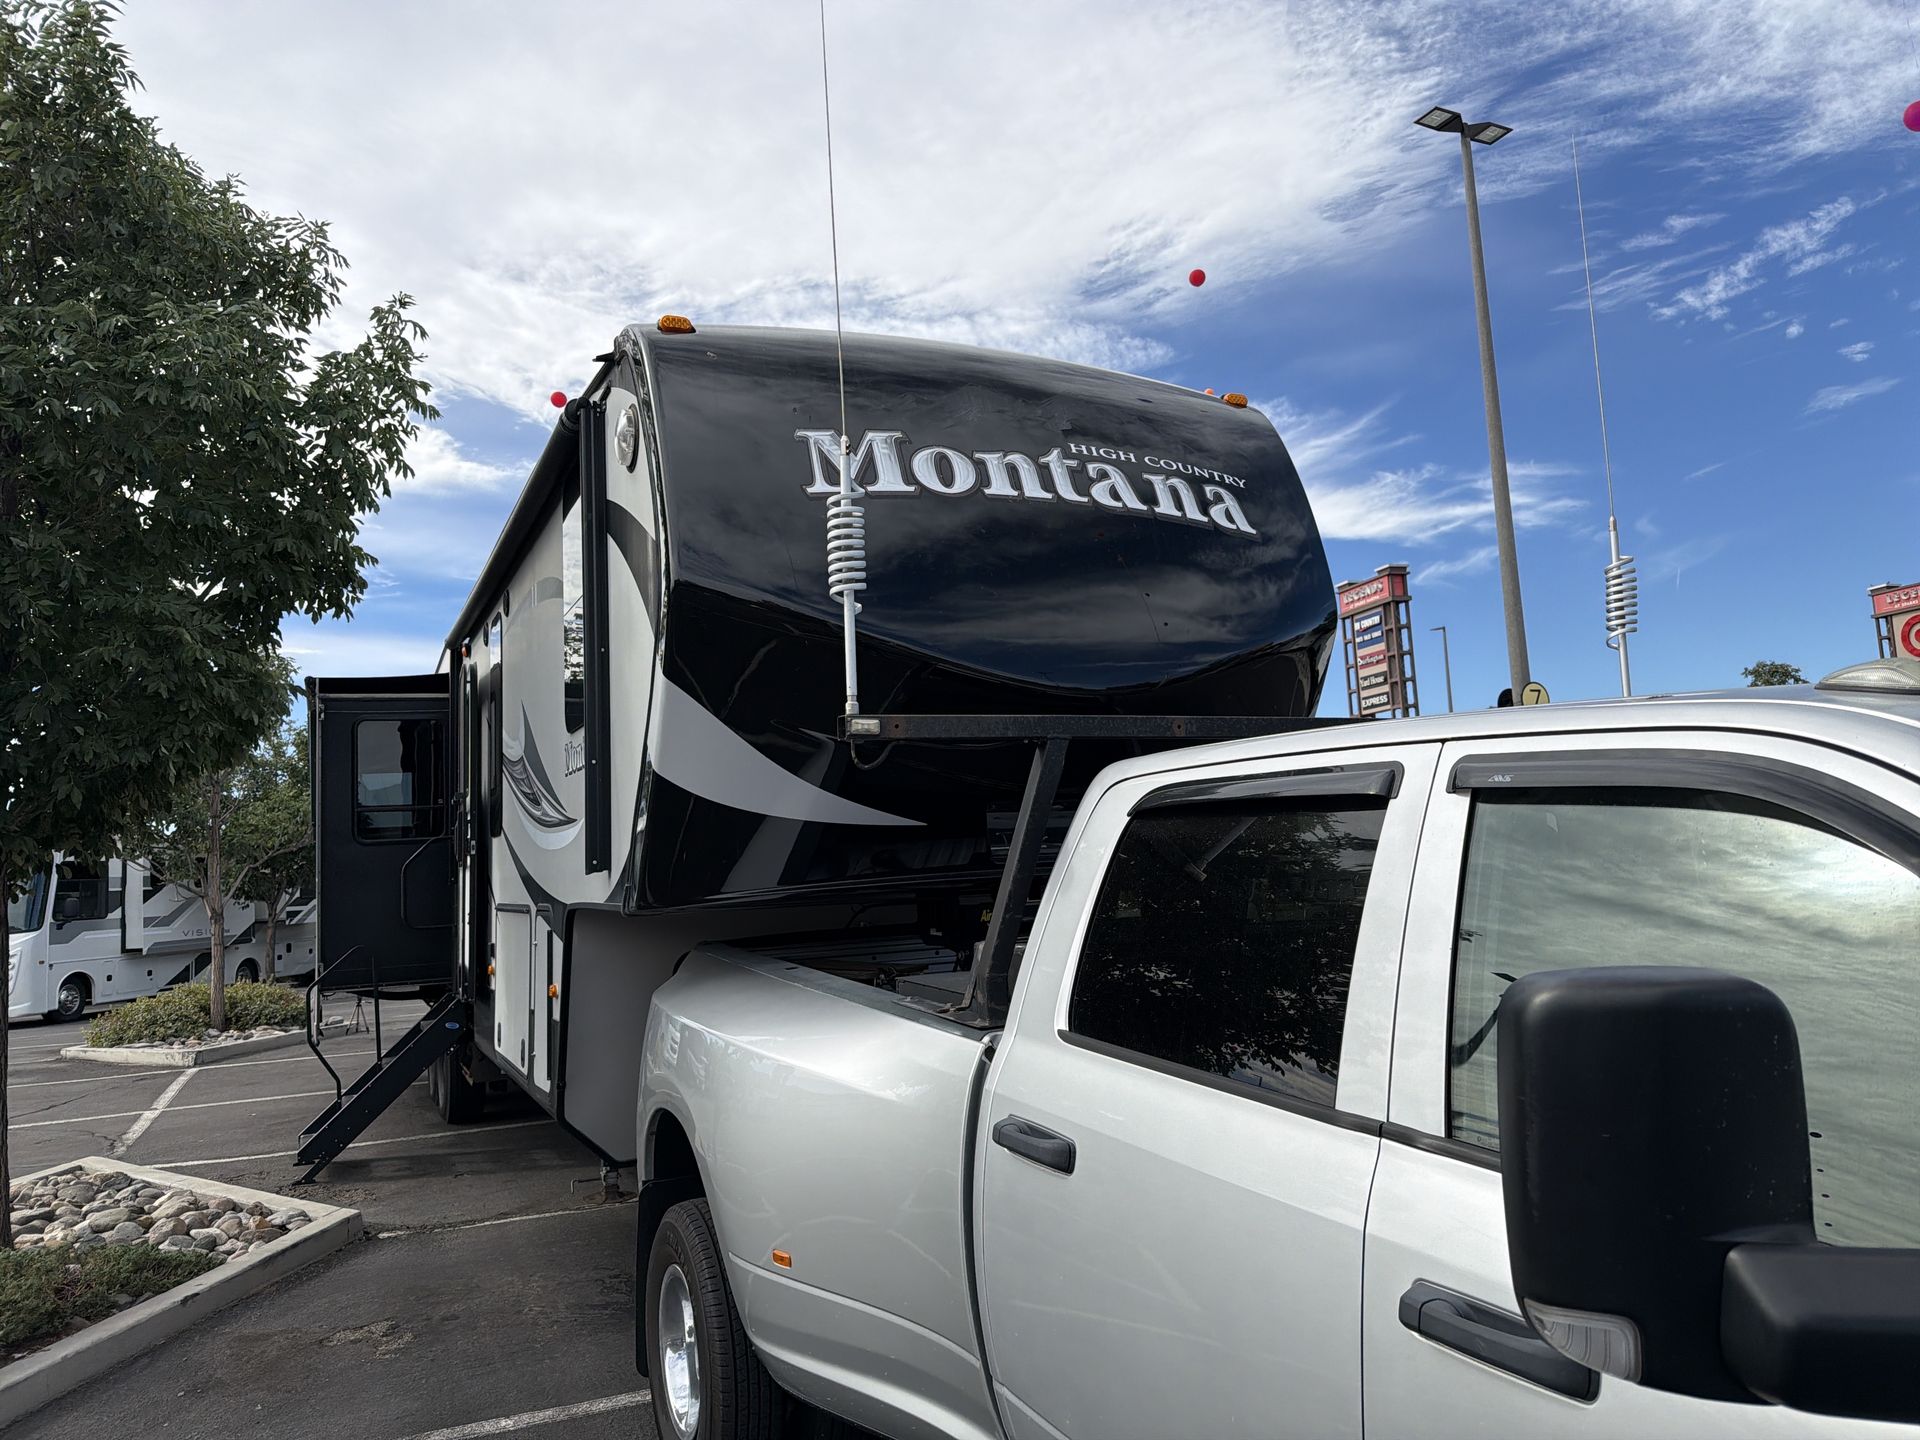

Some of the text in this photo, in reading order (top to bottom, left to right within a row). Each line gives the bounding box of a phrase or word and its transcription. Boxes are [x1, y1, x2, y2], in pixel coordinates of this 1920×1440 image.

[1067, 442, 1247, 490] HIGH COUNTRY
[794, 428, 1258, 536] Montana
[1357, 654, 1384, 666] Burlington
[1370, 675, 1385, 685] House
[1362, 694, 1388, 709] EXPRESS
[1529, 688, 1541, 705] 7
